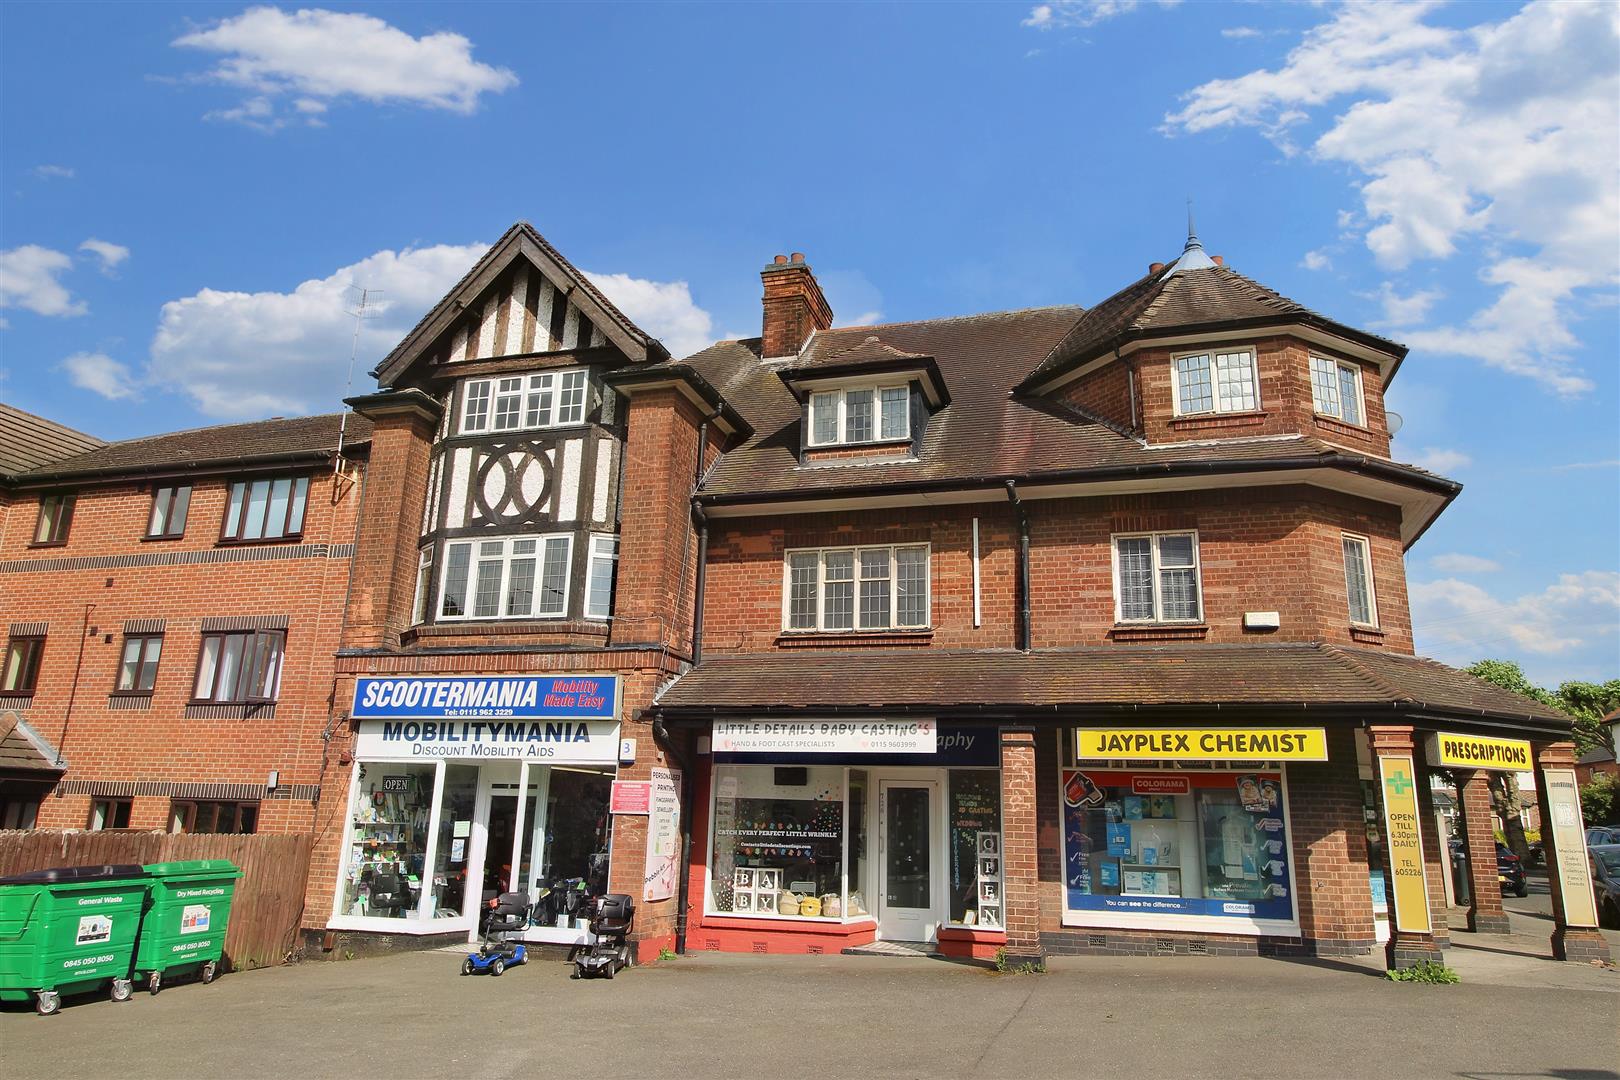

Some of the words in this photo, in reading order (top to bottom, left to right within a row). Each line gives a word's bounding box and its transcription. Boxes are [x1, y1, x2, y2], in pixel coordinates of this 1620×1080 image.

[552, 680, 599, 693] Mobility
[363, 680, 537, 708] SCOOTERMANIA
[544, 694, 575, 707] Made
[578, 694, 606, 711] Easy
[444, 708, 458, 716] Tel:
[459, 708, 478, 716] 0115
[479, 708, 493, 716] 962
[494, 708, 513, 716] 3229
[383, 721, 590, 743] MOBILITYMANIA
[718, 723, 760, 735] LITTLE
[764, 723, 816, 736] DETAILS
[820, 723, 857, 736] BABY
[861, 723, 930, 737] CASTING'S
[624, 742, 631, 754] 3
[795, 740, 836, 748] SPECIALISTS
[1096, 734, 1190, 752] JAYPLEX
[1200, 734, 1307, 753] CHEMIST
[412, 744, 467, 756] DISCOUNT
[470, 744, 522, 757] MOBILITY
[527, 744, 554, 757] AIDS
[1444, 740, 1527, 765] PRESCRIPTIONS
[385, 779, 409, 790] OPEN
[1136, 780, 1185, 788] COLORAMA
[1390, 813, 1415, 822] OPEN
[1396, 822, 1413, 830] TILL
[1391, 831, 1418, 840] 6.30pm
[1393, 840, 1418, 848] DAILY
[1395, 867, 1422, 877] 605226
[177, 890, 187, 898] Dry
[202, 888, 225, 896] Recycling
[78, 897, 103, 905] General
[104, 896, 123, 904] Waste
[1142, 900, 1152, 908] the
[172, 943, 187, 952] 0845
[187, 942, 198, 950] 050
[198, 940, 211, 948] 8050
[63, 959, 82, 968] 0845
[82, 957, 97, 965] 050
[97, 954, 114, 963] 8050
